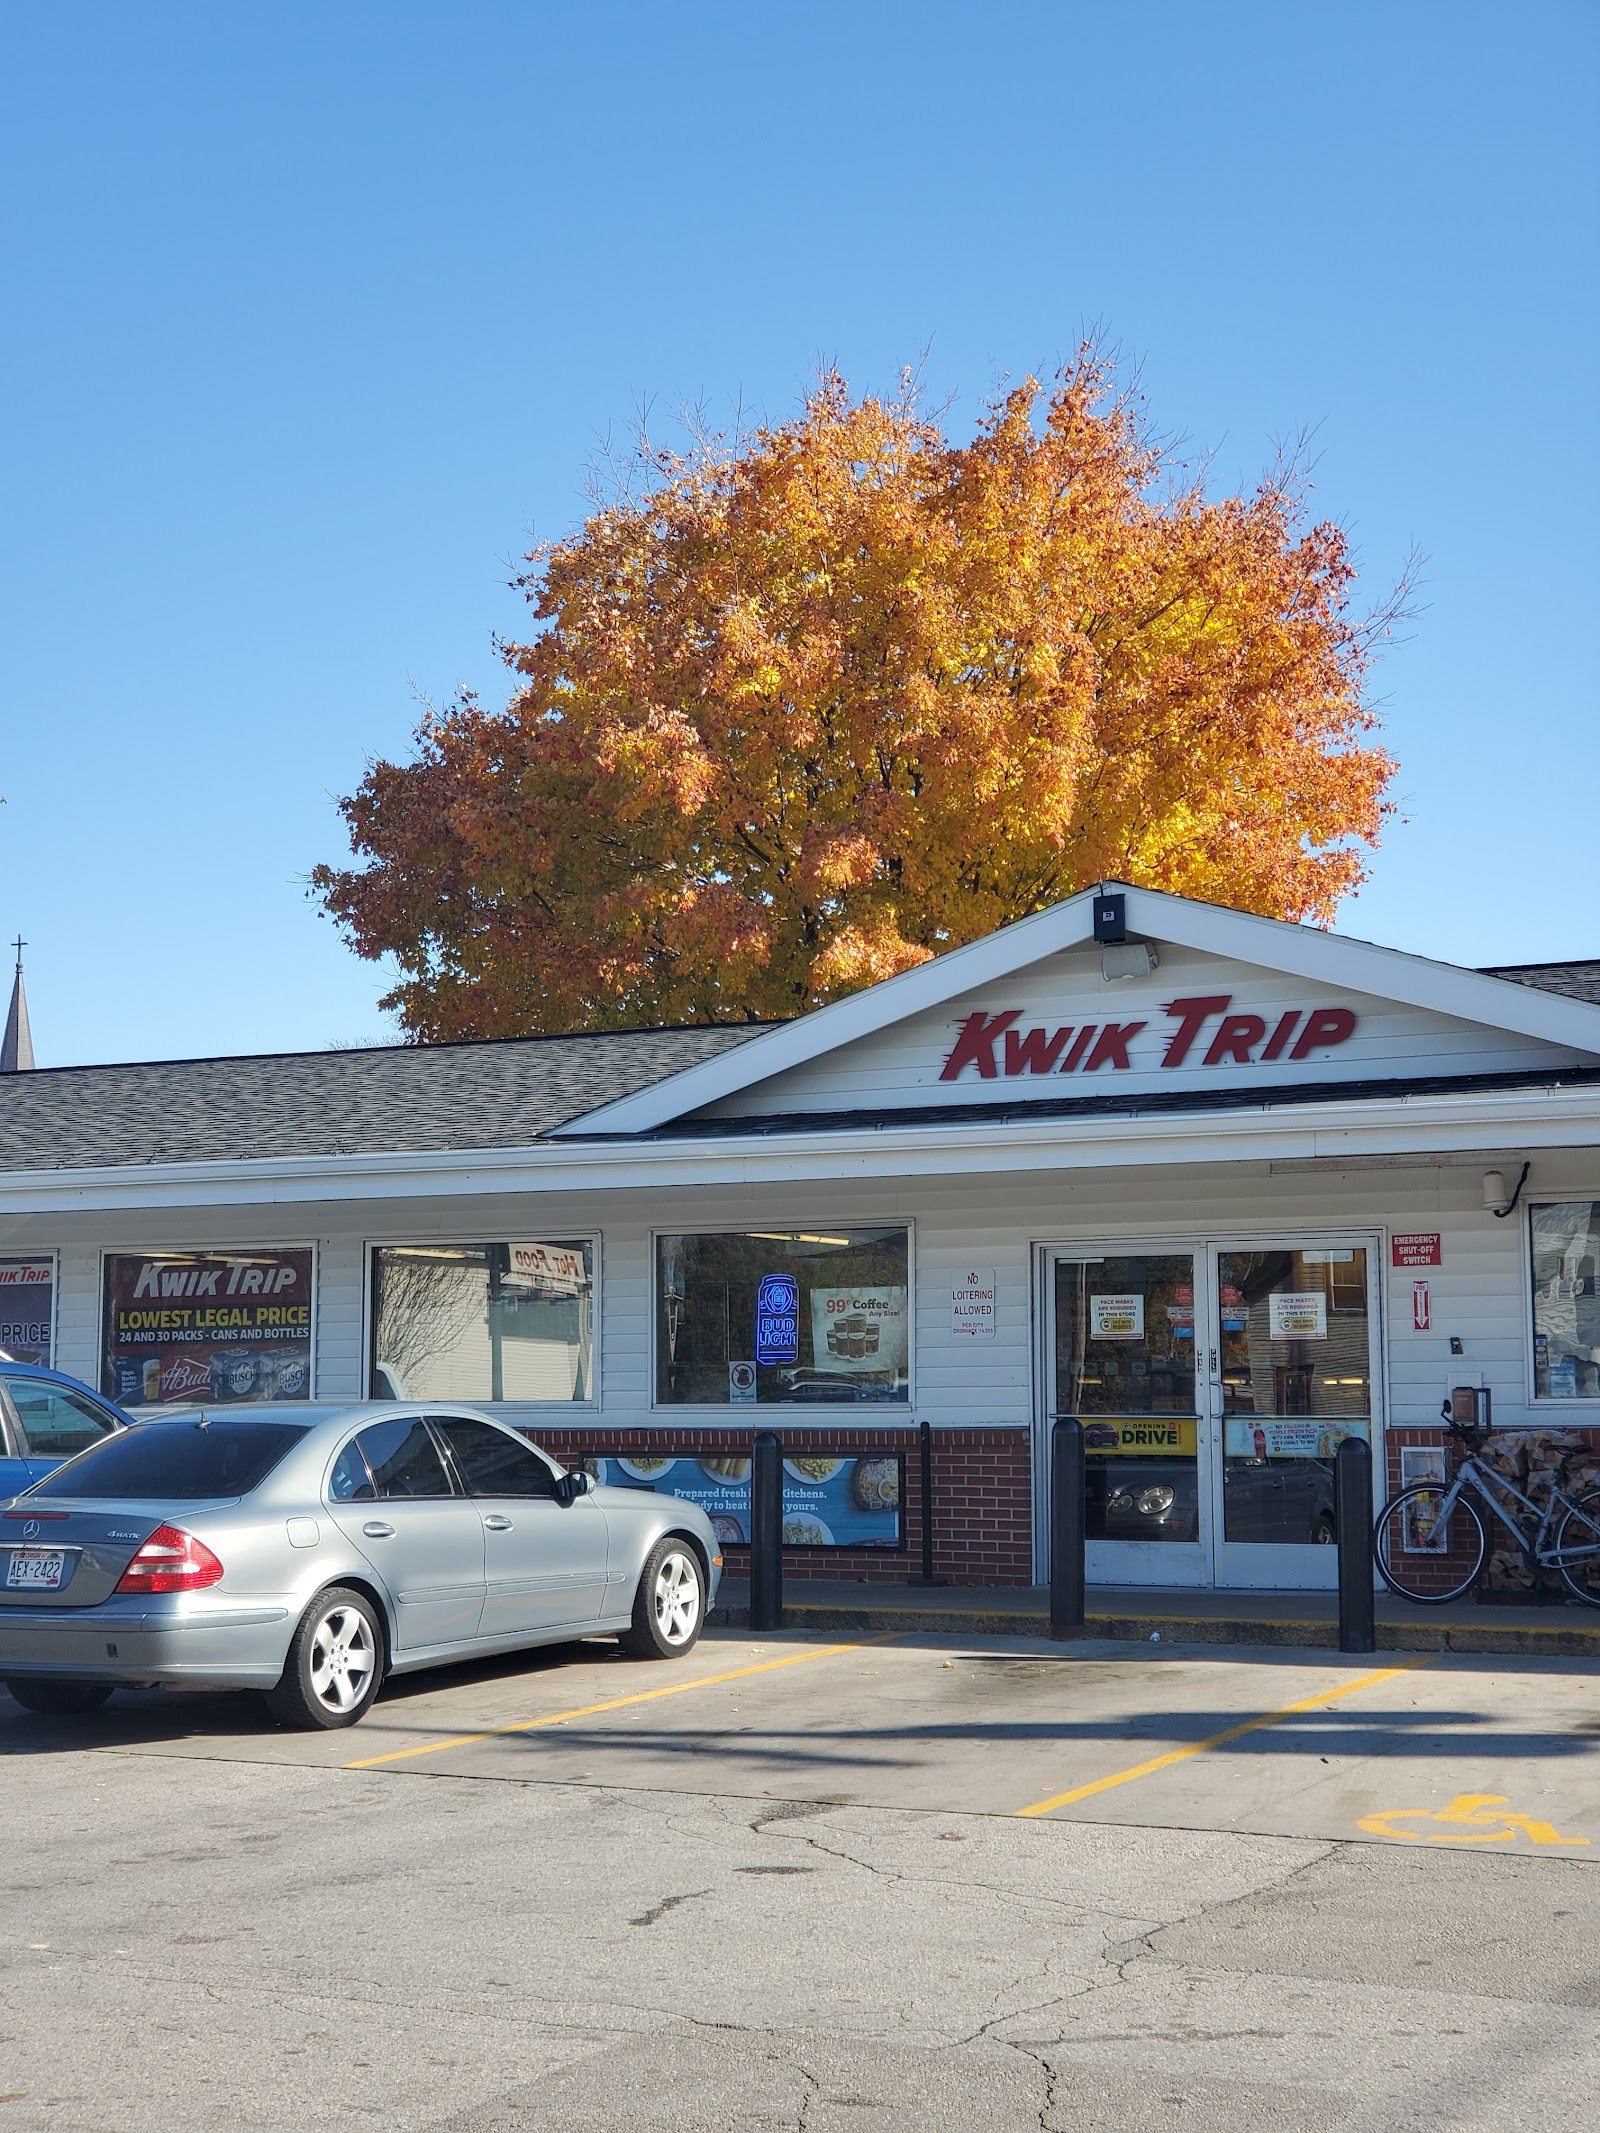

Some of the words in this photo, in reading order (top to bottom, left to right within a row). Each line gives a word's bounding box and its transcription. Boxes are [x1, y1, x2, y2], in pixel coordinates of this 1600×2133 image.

[938, 1009, 1149, 1081] KWIK
[1155, 995, 1357, 1068] TRIP
[1394, 1235, 1438, 1244] EMERGENCY
[1398, 1246, 1434, 1254] SHUT-OFF
[1403, 1256, 1431, 1264] SWITCH
[20, 1266, 50, 1282] TRIP
[133, 1263, 223, 1298] KWIK
[226, 1262, 297, 1295] TRIP
[967, 1275, 979, 1284] NO
[952, 1290, 993, 1300] LOITERING
[852, 1298, 889, 1309] Coffee
[954, 1305, 992, 1315] ALLOWED
[119, 1310, 192, 1329] LOWEST
[195, 1308, 252, 1327] LEGAL
[256, 1306, 309, 1325] PRICE
[761, 1318, 795, 1332] BUD
[1, 1322, 50, 1344] PRICE
[119, 1332, 132, 1342] 24
[133, 1331, 156, 1342] AND
[157, 1331, 169, 1341] 30
[171, 1330, 204, 1341] PACKS
[211, 1329, 238, 1340] CANS
[239, 1328, 263, 1339] AND
[264, 1327, 309, 1339] BOTTLES
[759, 1332, 797, 1346] LIGHT
[164, 1362, 211, 1391] Bud
[229, 1368, 257, 1385] BUSCH
[280, 1369, 306, 1385] BUSCH
[1122, 1430, 1178, 1445] DRIVE
[673, 1488, 720, 1500] Prepared
[720, 1488, 747, 1498] fresh
[714, 1502, 724, 1510] to
[725, 1500, 747, 1510] heat
[786, 1503, 819, 1513] yours.
[9, 1560, 61, 1578] AEX-2422
